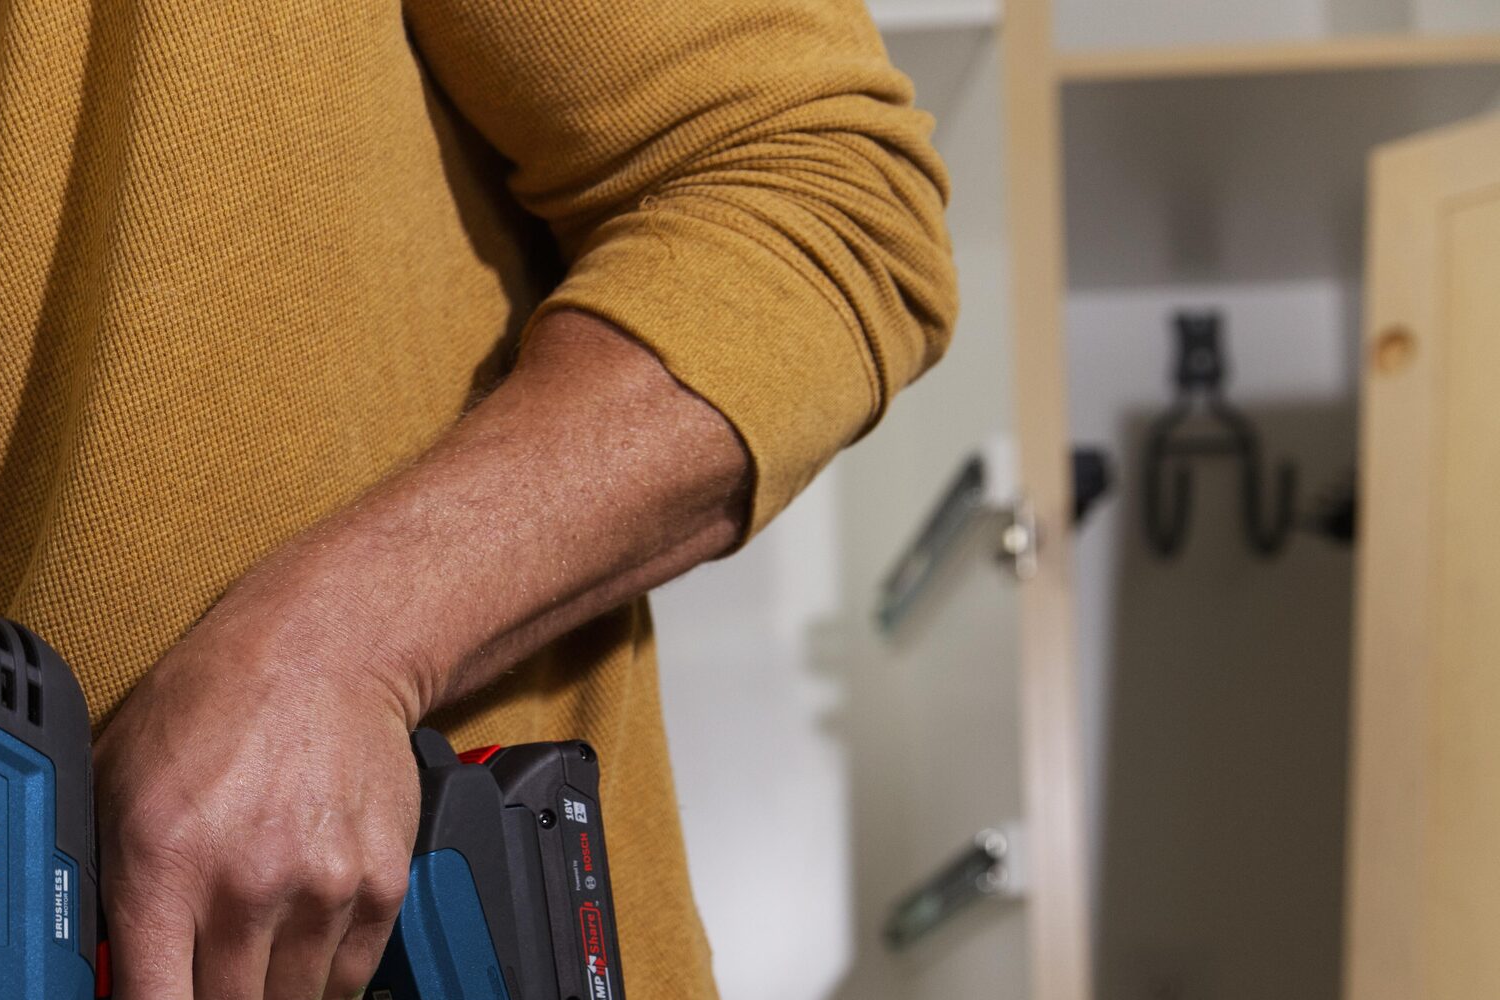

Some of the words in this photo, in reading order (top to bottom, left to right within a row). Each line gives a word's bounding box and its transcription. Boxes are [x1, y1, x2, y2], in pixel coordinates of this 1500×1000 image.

[563, 798, 574, 820] 18V
[580, 832, 593, 872] BOSCH
[54, 868, 63, 939] BRUSHLESS
[587, 913, 600, 954] Share
